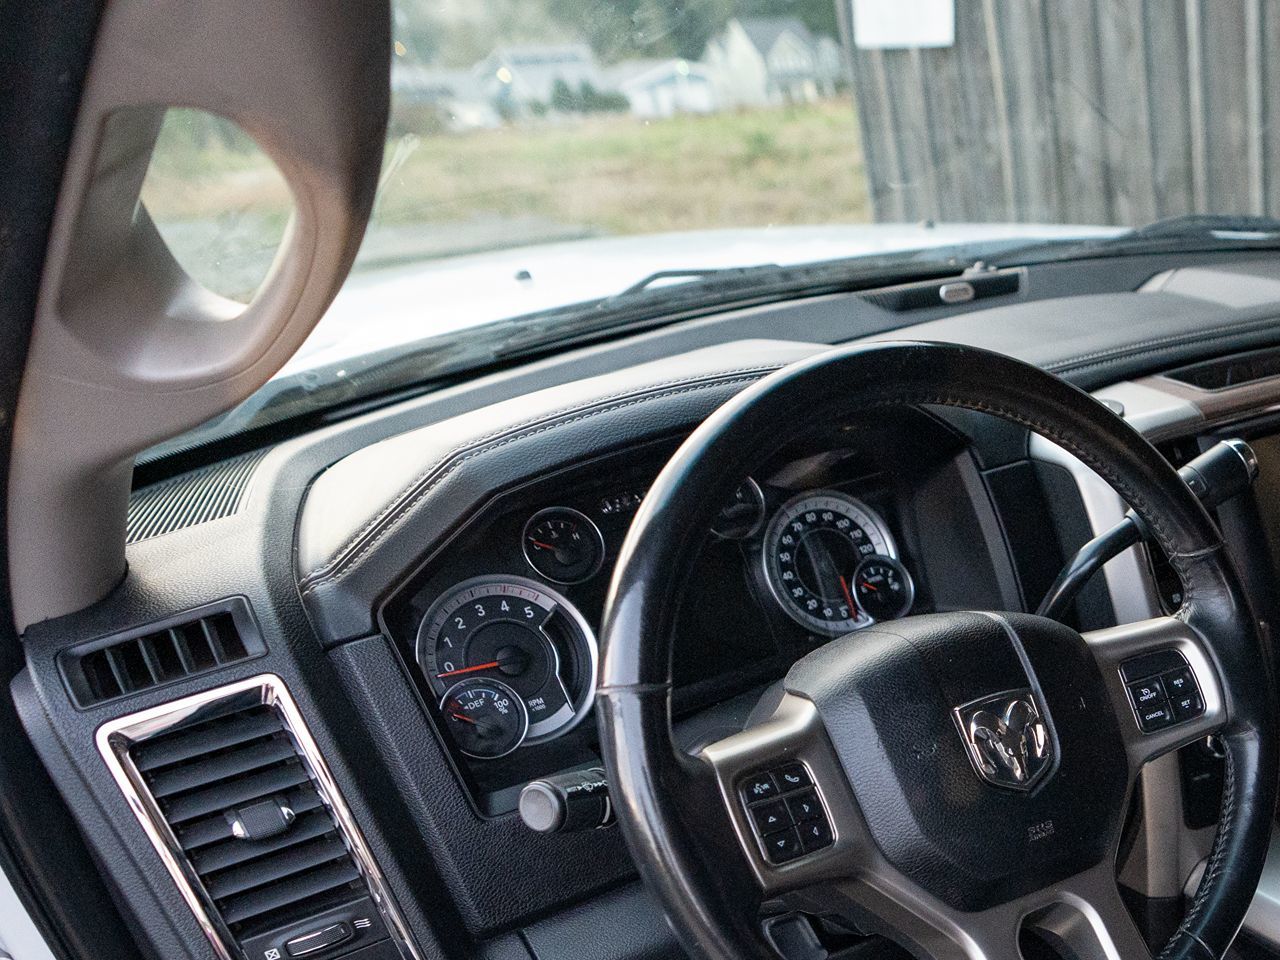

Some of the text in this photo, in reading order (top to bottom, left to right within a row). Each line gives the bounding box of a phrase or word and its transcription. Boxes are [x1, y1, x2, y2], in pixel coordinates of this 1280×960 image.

[805, 512, 816, 523] 80
[822, 512, 834, 522] 90
[792, 522, 803, 532] 70
[836, 518, 850, 529] 100
[850, 528, 863, 539] 110
[782, 535, 793, 545] 60
[859, 544, 873, 555] 120
[779, 552, 791, 562] 50
[782, 571, 793, 581] 40
[792, 588, 803, 598] 30
[475, 604, 486, 616] 3
[500, 600, 510, 612] 4
[806, 599, 818, 610] 20
[524, 606, 534, 618] 5
[823, 607, 833, 617] 10
[455, 617, 466, 630] 2
[444, 637, 453, 648] 1
[444, 661, 454, 672] 0
[469, 698, 485, 710] DEF
[494, 698, 509, 710] 100
[528, 697, 544, 707] RPM
[1145, 710, 1164, 720] CANCEL
